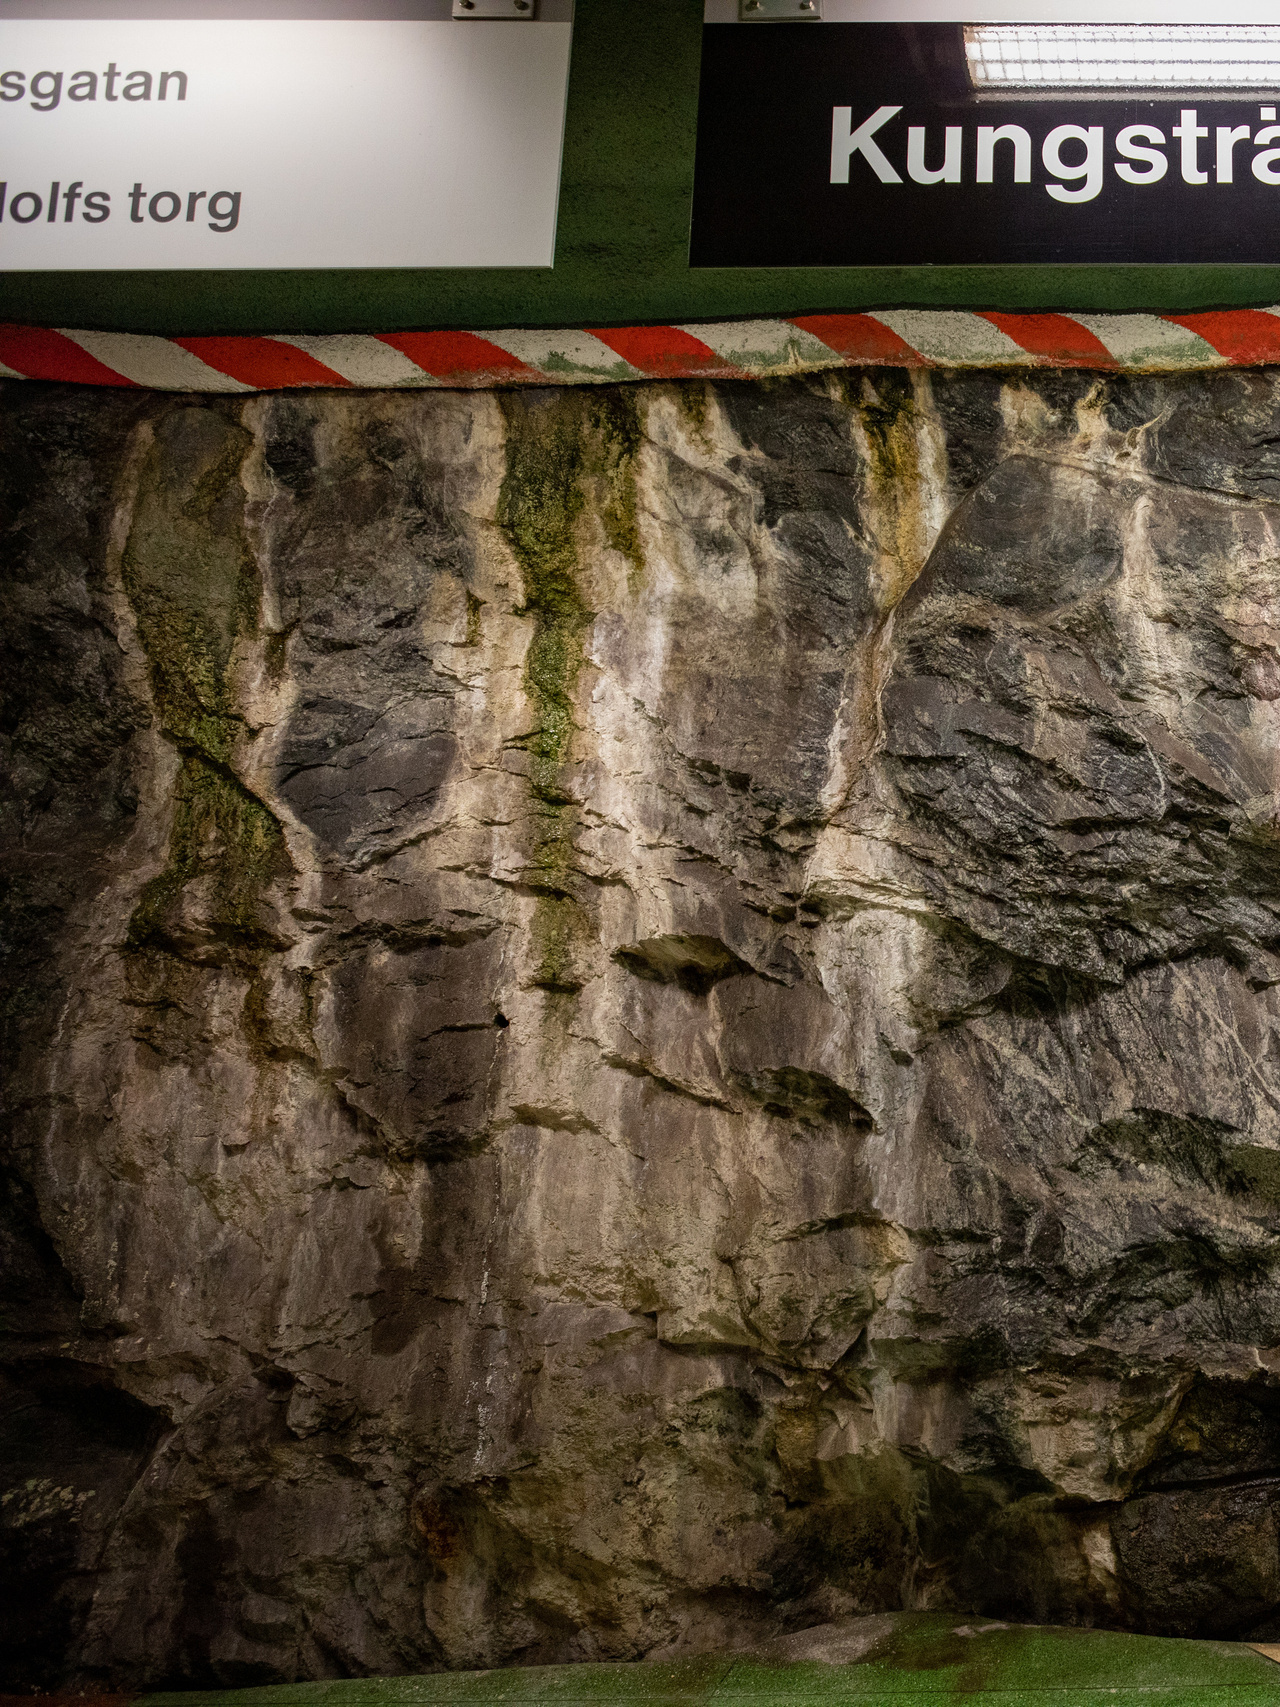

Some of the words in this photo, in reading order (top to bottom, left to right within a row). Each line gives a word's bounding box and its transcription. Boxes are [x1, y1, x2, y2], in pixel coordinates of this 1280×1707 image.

[0, 62, 188, 112] sgatan
[0, 181, 111, 224] olfs
[128, 182, 242, 233] torg
